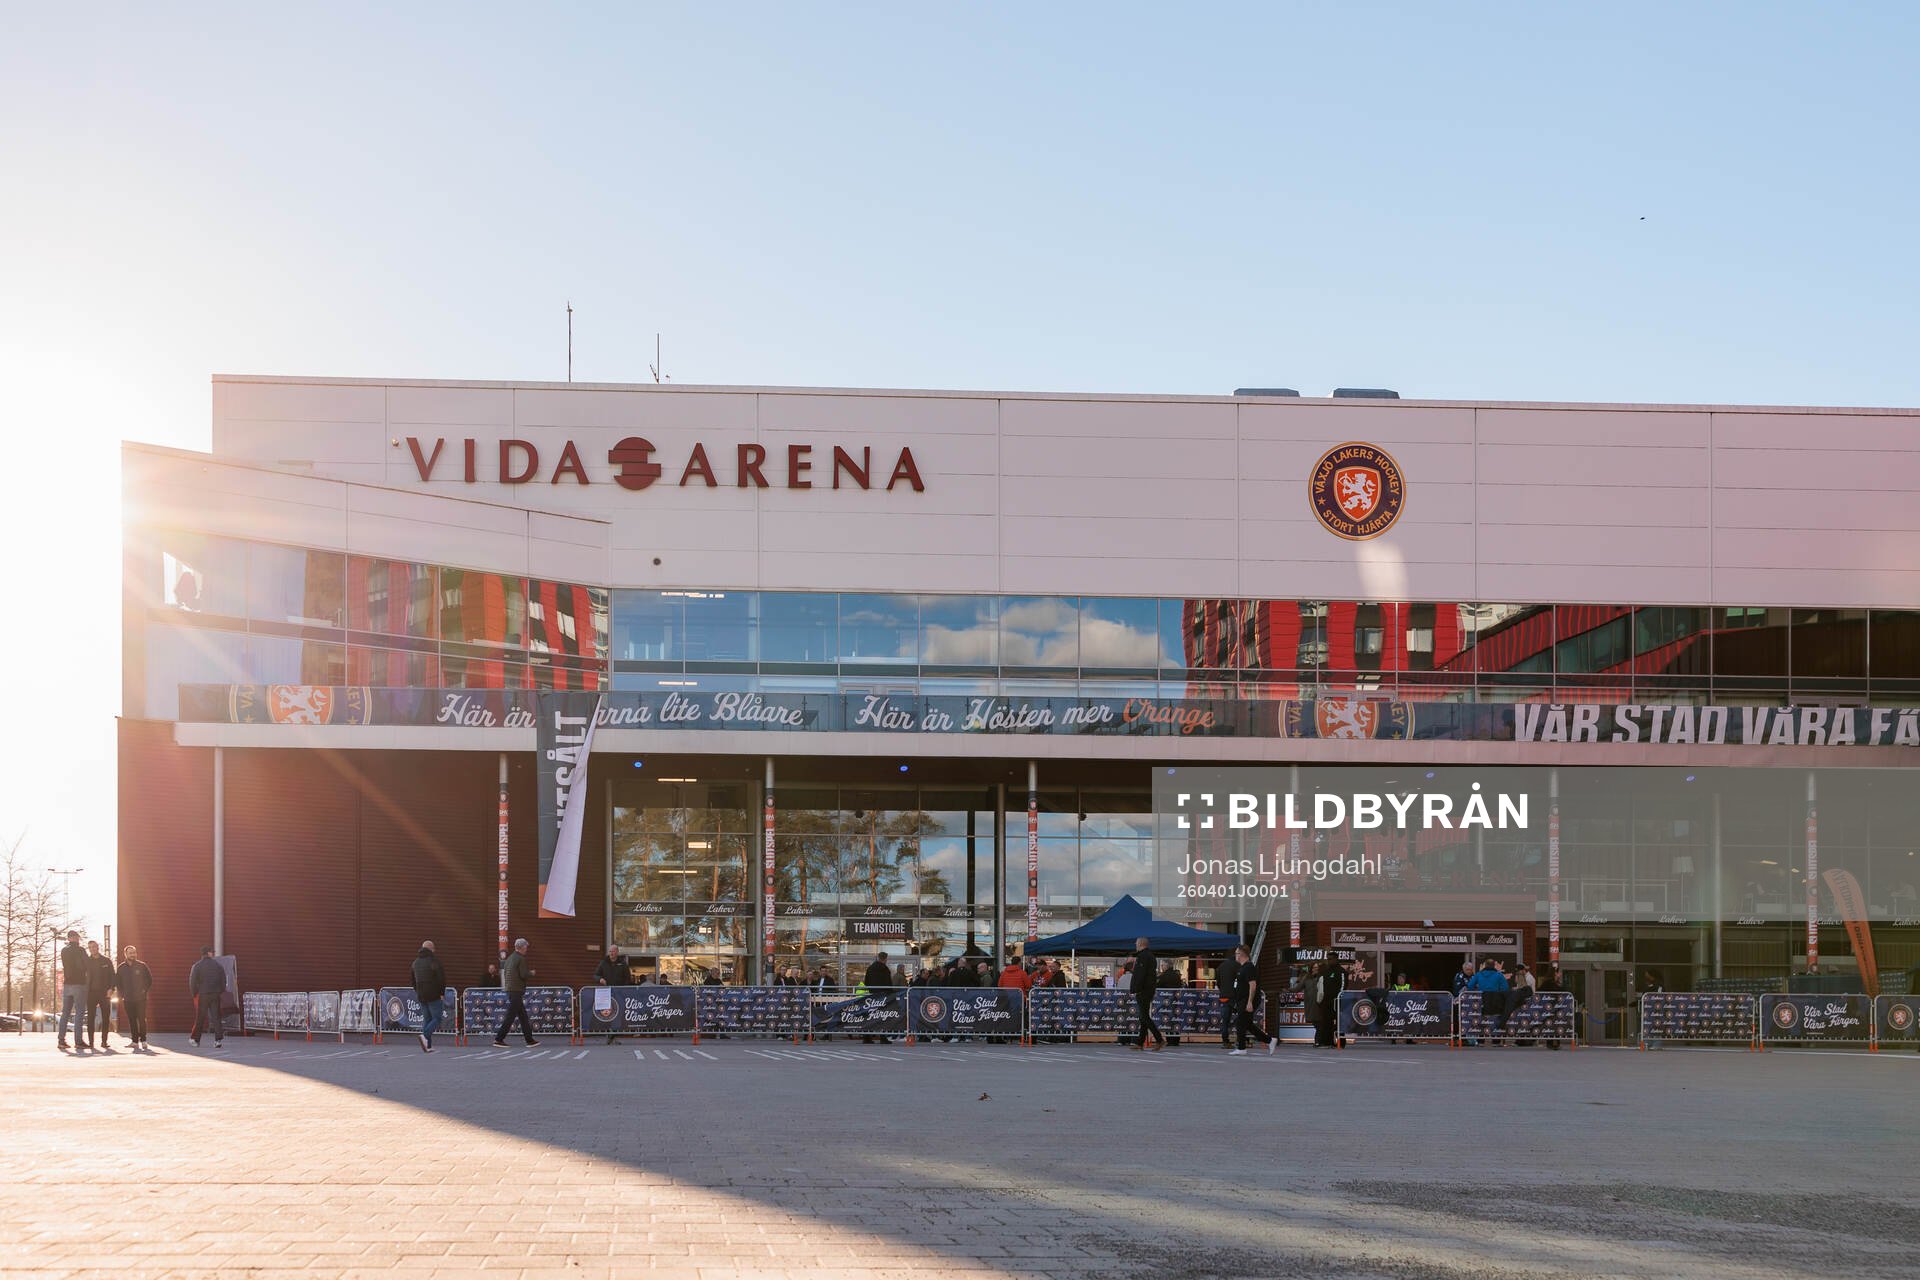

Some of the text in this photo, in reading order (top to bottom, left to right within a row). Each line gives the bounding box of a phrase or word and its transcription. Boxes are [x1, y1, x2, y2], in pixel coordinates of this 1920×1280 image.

[405, 438, 926, 493] VIDA ARENA
[1315, 448, 1400, 495] VÄXJÖ LAKERS HOCKEY
[1322, 509, 1394, 535] STORT HJÄRTA
[436, 693, 497, 729] Här
[503, 704, 536, 729] är
[659, 692, 702, 722] lite
[709, 692, 804, 726] Blåare
[854, 695, 1217, 734] Här är Hösten mer Orange
[1612, 704, 1727, 744] STAD
[853, 922, 906, 934] TEAMSTORE
[1296, 949, 1323, 960] VÄXJÖ
[1323, 950, 1350, 960] LERS
[646, 994, 670, 1007] Stad
[863, 996, 887, 1009] Stad
[973, 996, 998, 1009] Stad
[1403, 999, 1427, 1012] Stad
[1823, 1002, 1847, 1015] Stad
